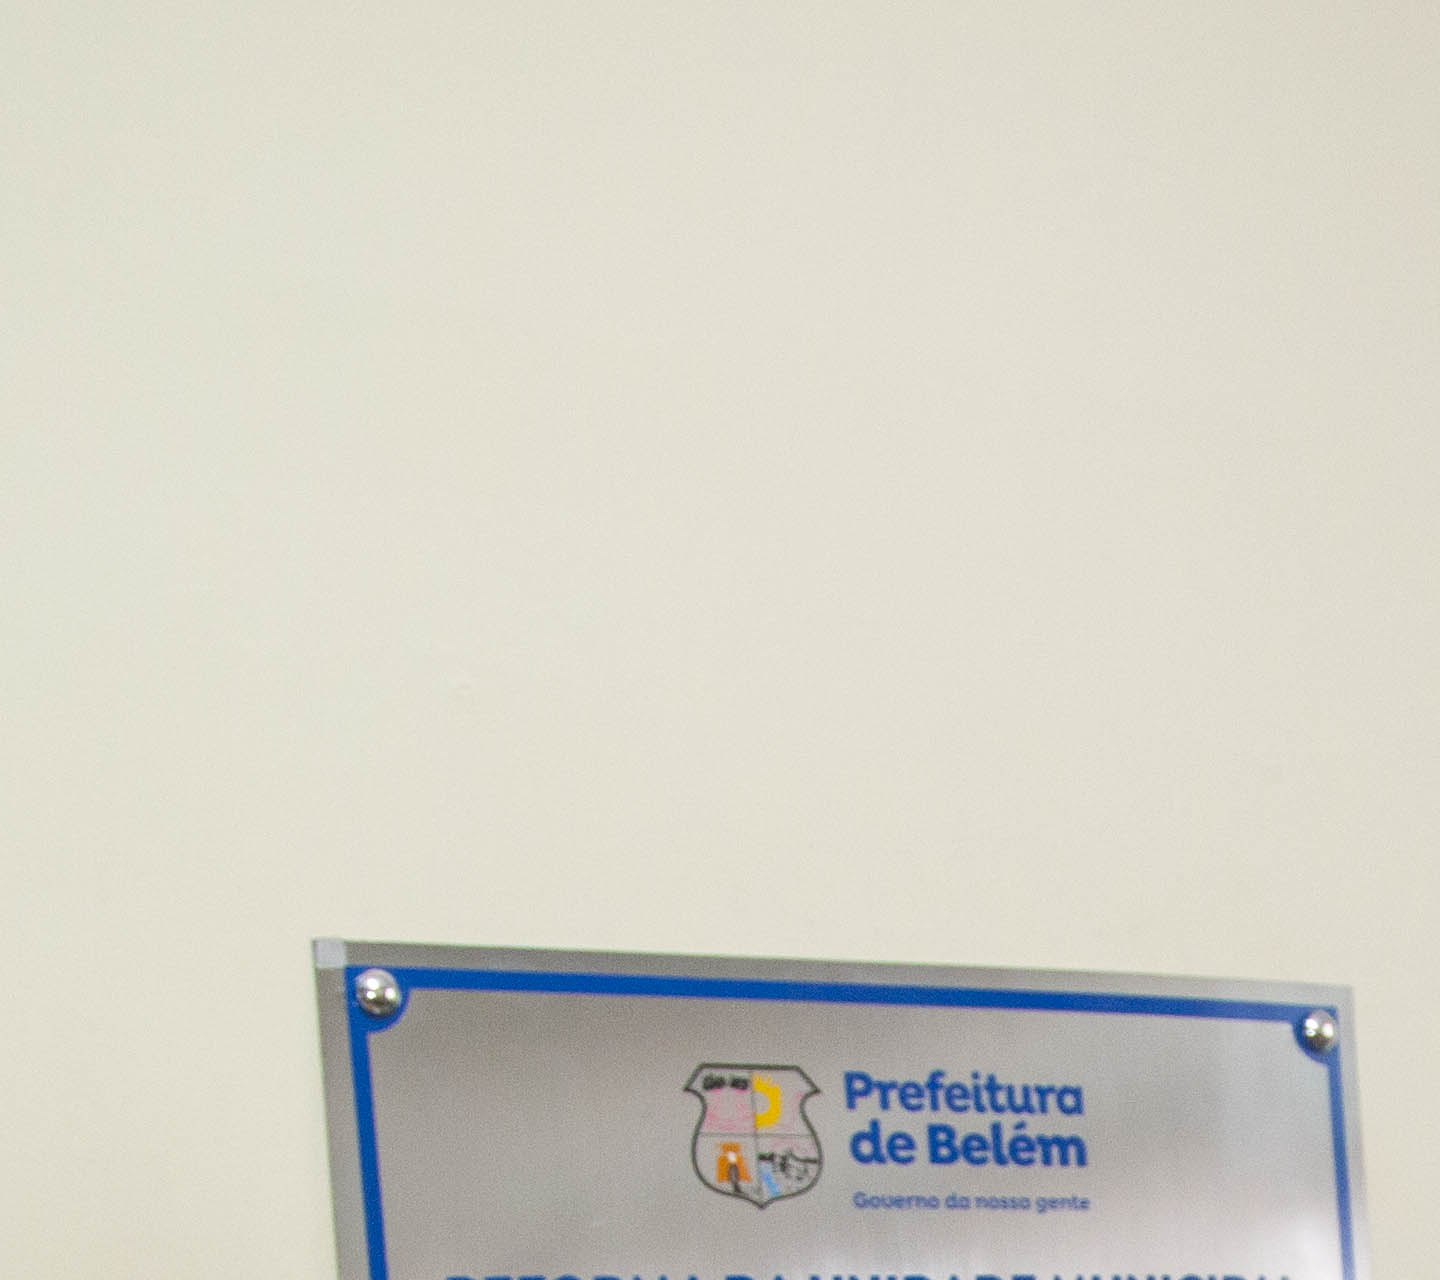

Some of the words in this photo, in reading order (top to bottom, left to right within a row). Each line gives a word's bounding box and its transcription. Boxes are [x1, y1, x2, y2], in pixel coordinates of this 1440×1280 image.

[844, 1070, 1084, 1116] Prefeitura
[849, 1119, 917, 1166] de
[927, 1121, 1089, 1168] Belém
[852, 1192, 940, 1212] Governo
[944, 1191, 972, 1211] da
[975, 1195, 1032, 1212] nossa
[1035, 1193, 1090, 1214] gente
